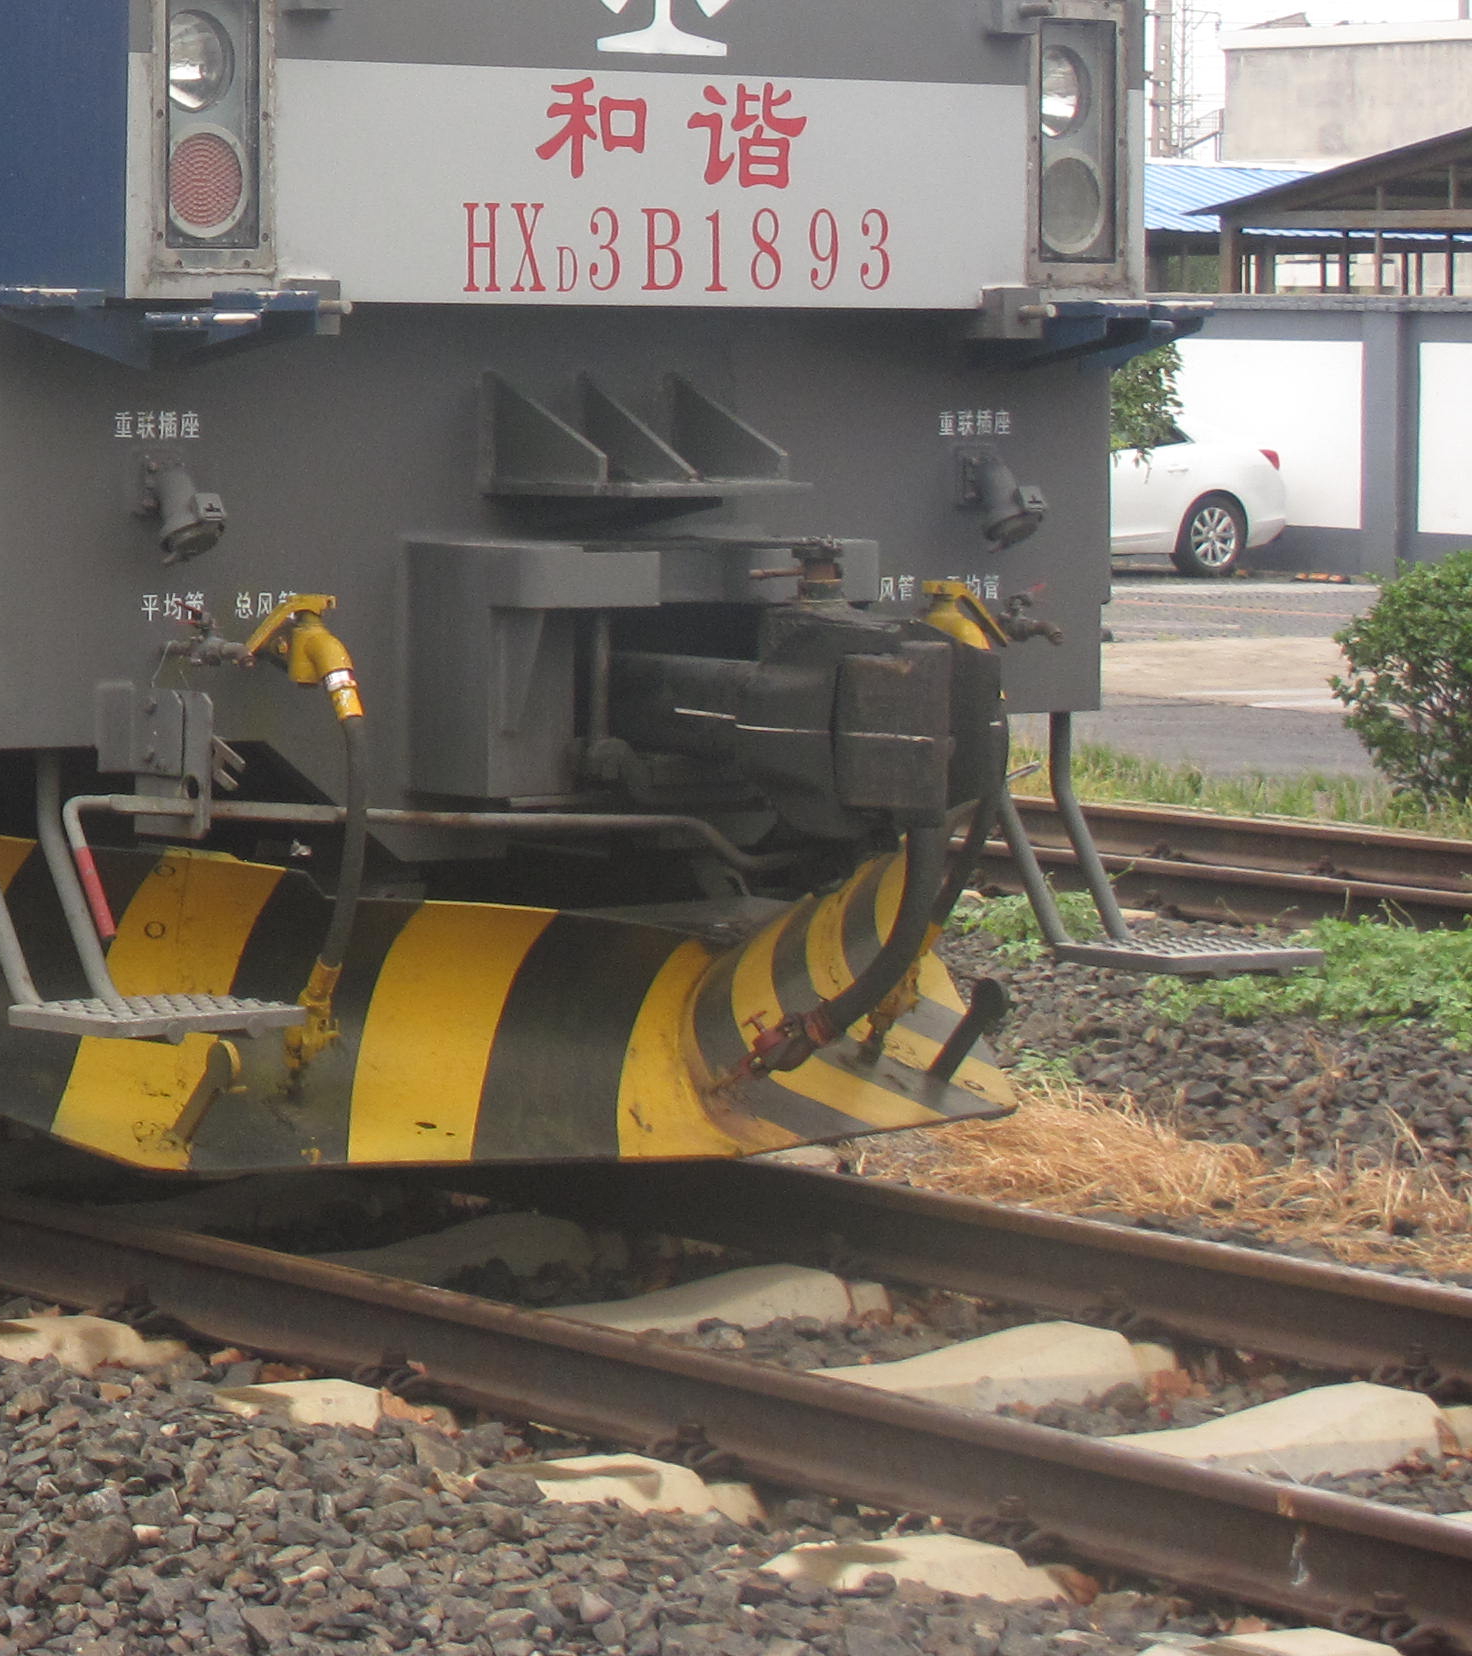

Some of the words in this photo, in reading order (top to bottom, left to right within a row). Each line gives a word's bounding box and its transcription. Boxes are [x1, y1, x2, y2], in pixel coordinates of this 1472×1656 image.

[534, 76, 808, 189] 和谐
[462, 202, 891, 292] HXD3B1893
[114, 410, 200, 439] 重联插座
[938, 409, 1012, 436] 重联插座
[946, 573, 1000, 601] 均管
